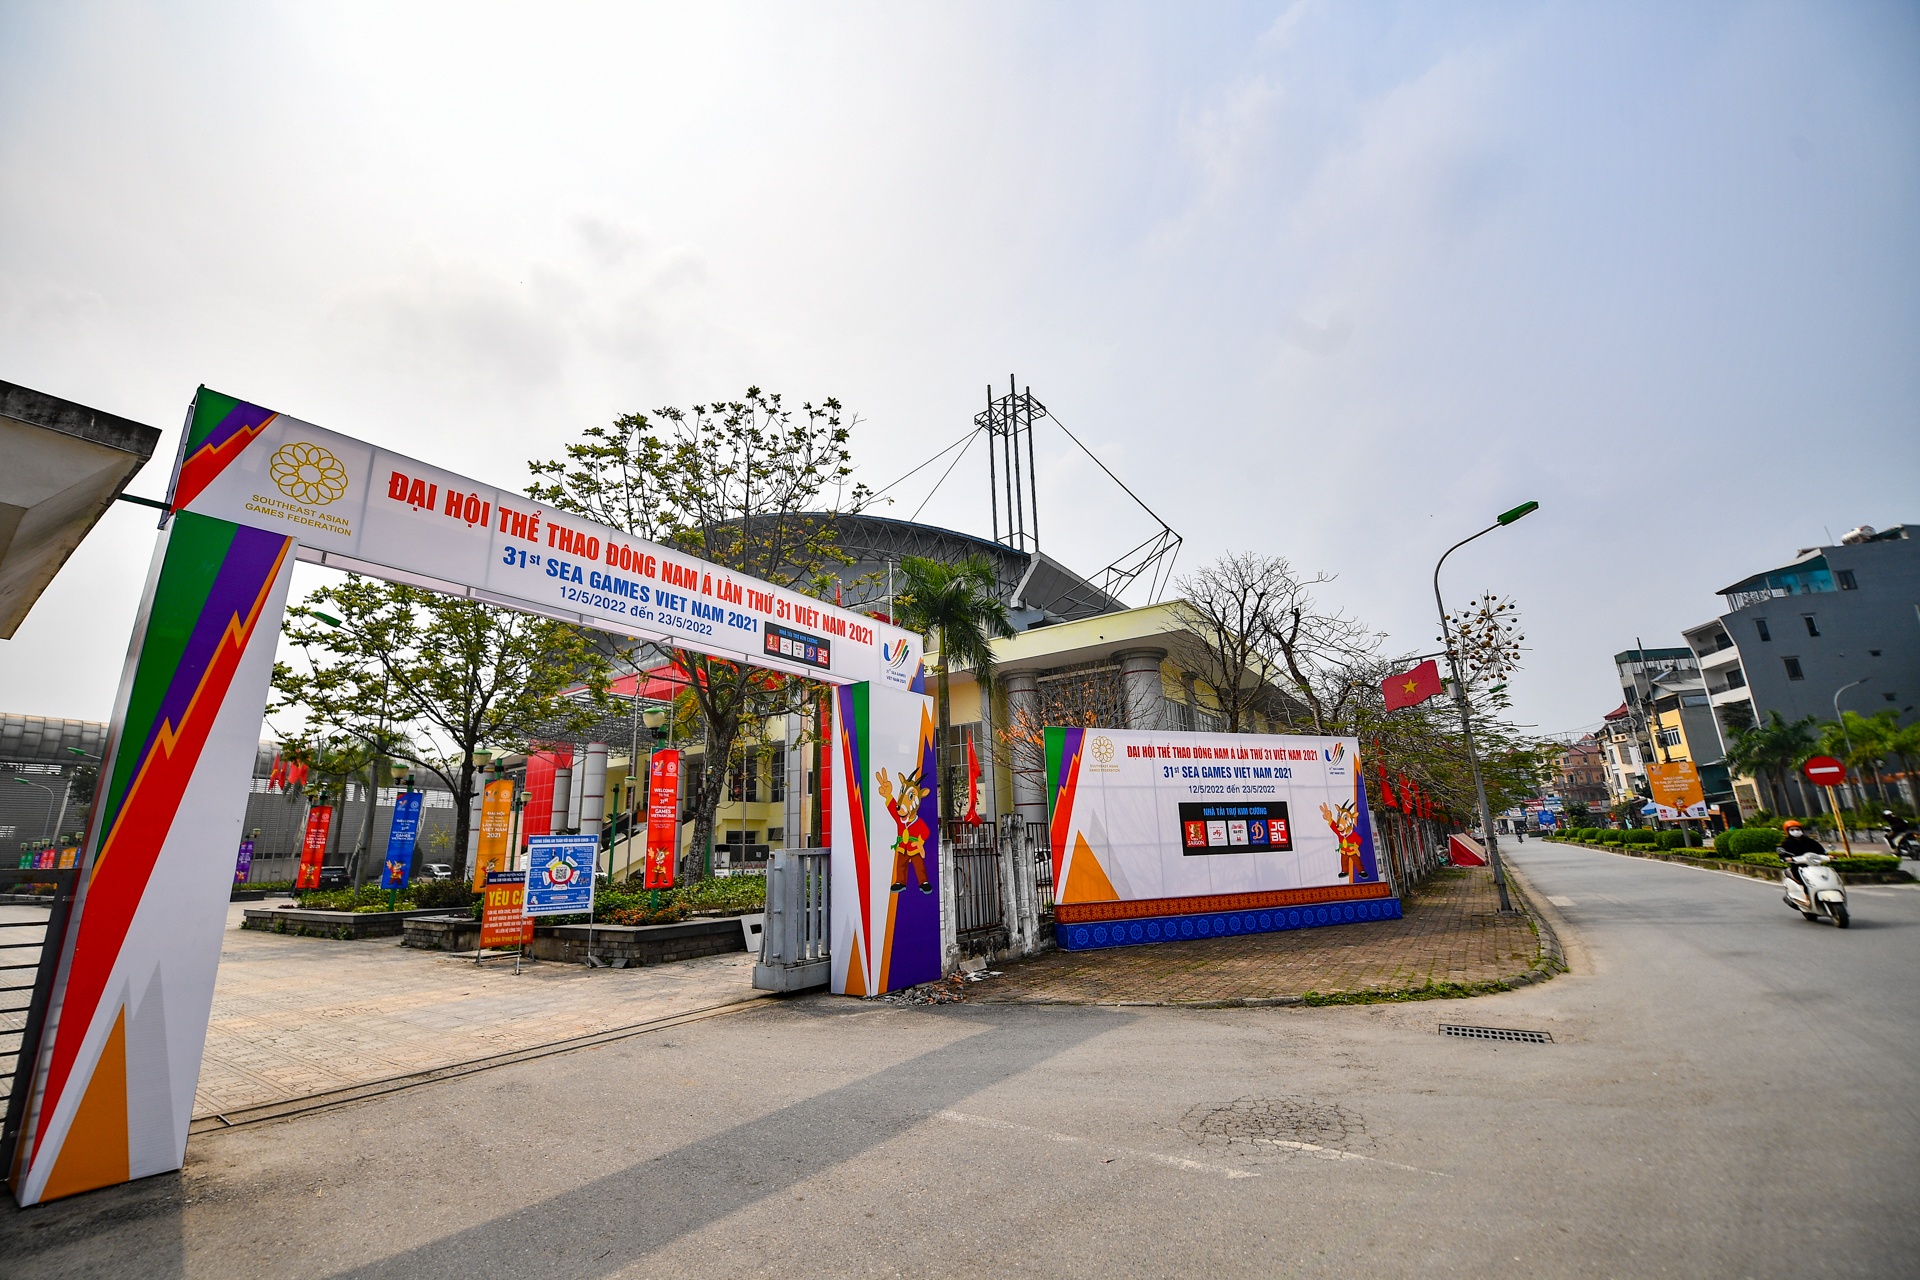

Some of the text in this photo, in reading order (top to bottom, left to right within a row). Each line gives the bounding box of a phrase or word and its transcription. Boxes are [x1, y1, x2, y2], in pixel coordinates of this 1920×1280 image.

[245, 503, 352, 536] GAMES FEDERATION
[252, 494, 349, 526] SOUTHEAST ASIAN
[388, 471, 873, 646] ĐẠI HỘI THỂ THAO ĐÔNG NAM Á LẦN THỨ 31 VIỆT NAM 2021
[503, 546, 757, 633] 31st SEA GAMES VIET NAM 2021
[560, 586, 713, 636] 12/5/2022 đến 23/5/2022
[1127, 743, 1318, 762] ĐẠI HỘI THỂ THAO ĐÔNG NAM Á LẦN THỨ 31 VIỆT NAM 2021
[1163, 766, 1292, 778] 31st SEA GAMES VIET NAM 2021
[1189, 784, 1275, 794] 12/5/2022 đến 23/5/2022
[1203, 806, 1215, 816] NHÀ
[1216, 807, 1226, 816] TÀI
[1226, 807, 1236, 817] TRỢ
[1238, 807, 1248, 815] KIM
[489, 888, 509, 906] YÊU
